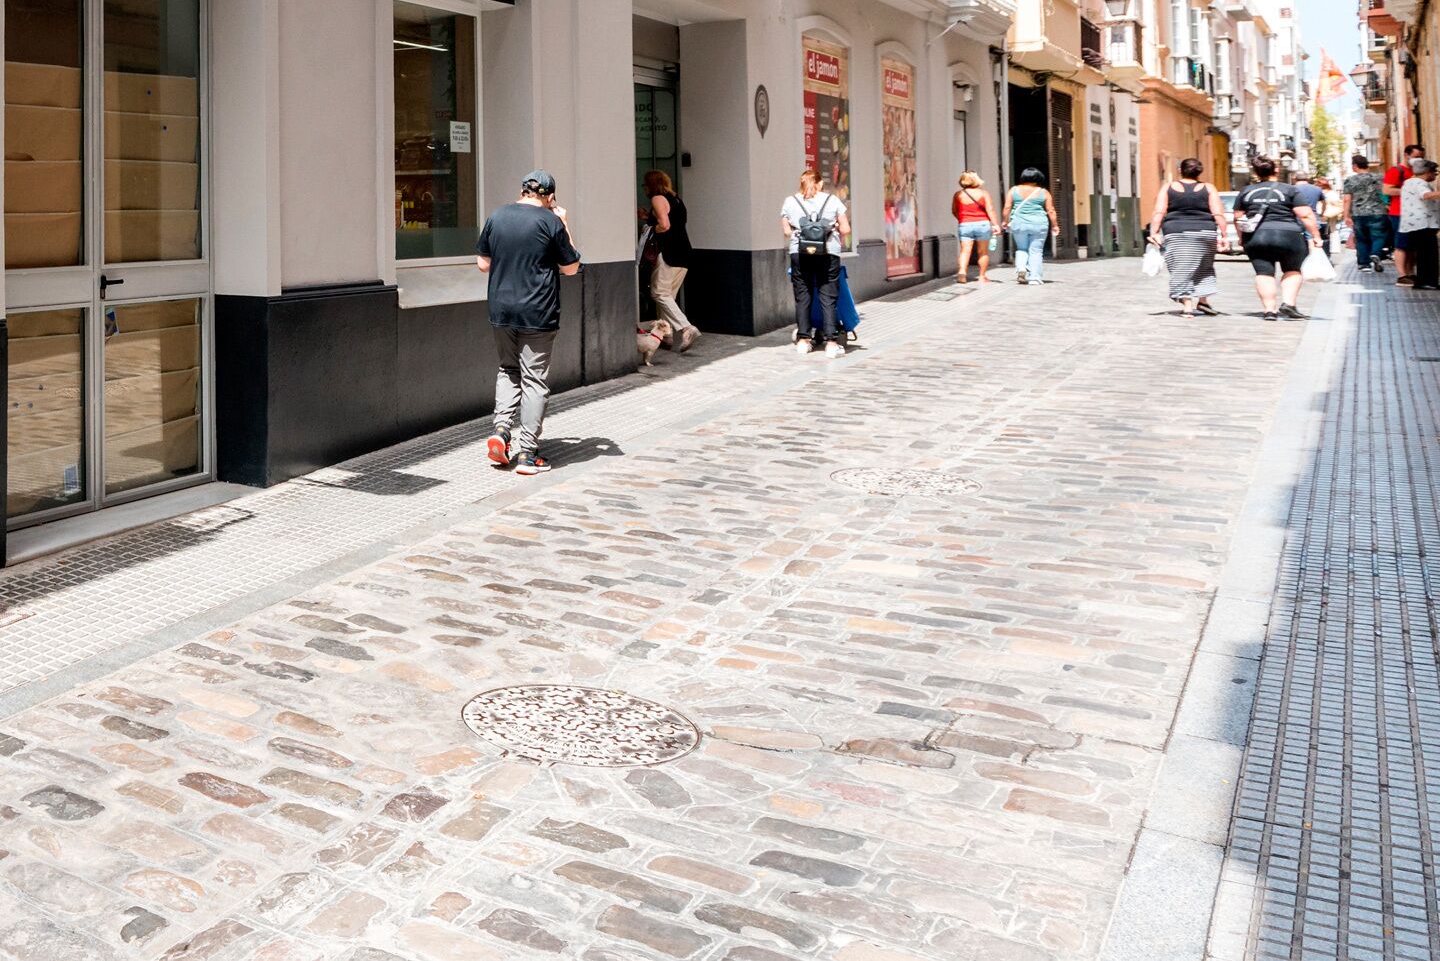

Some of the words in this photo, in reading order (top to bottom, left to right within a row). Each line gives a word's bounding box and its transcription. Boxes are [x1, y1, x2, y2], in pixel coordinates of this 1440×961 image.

[809, 53, 816, 74] el
[816, 54, 839, 80] jamón
[886, 71, 892, 89] el
[891, 73, 908, 94] jamón
